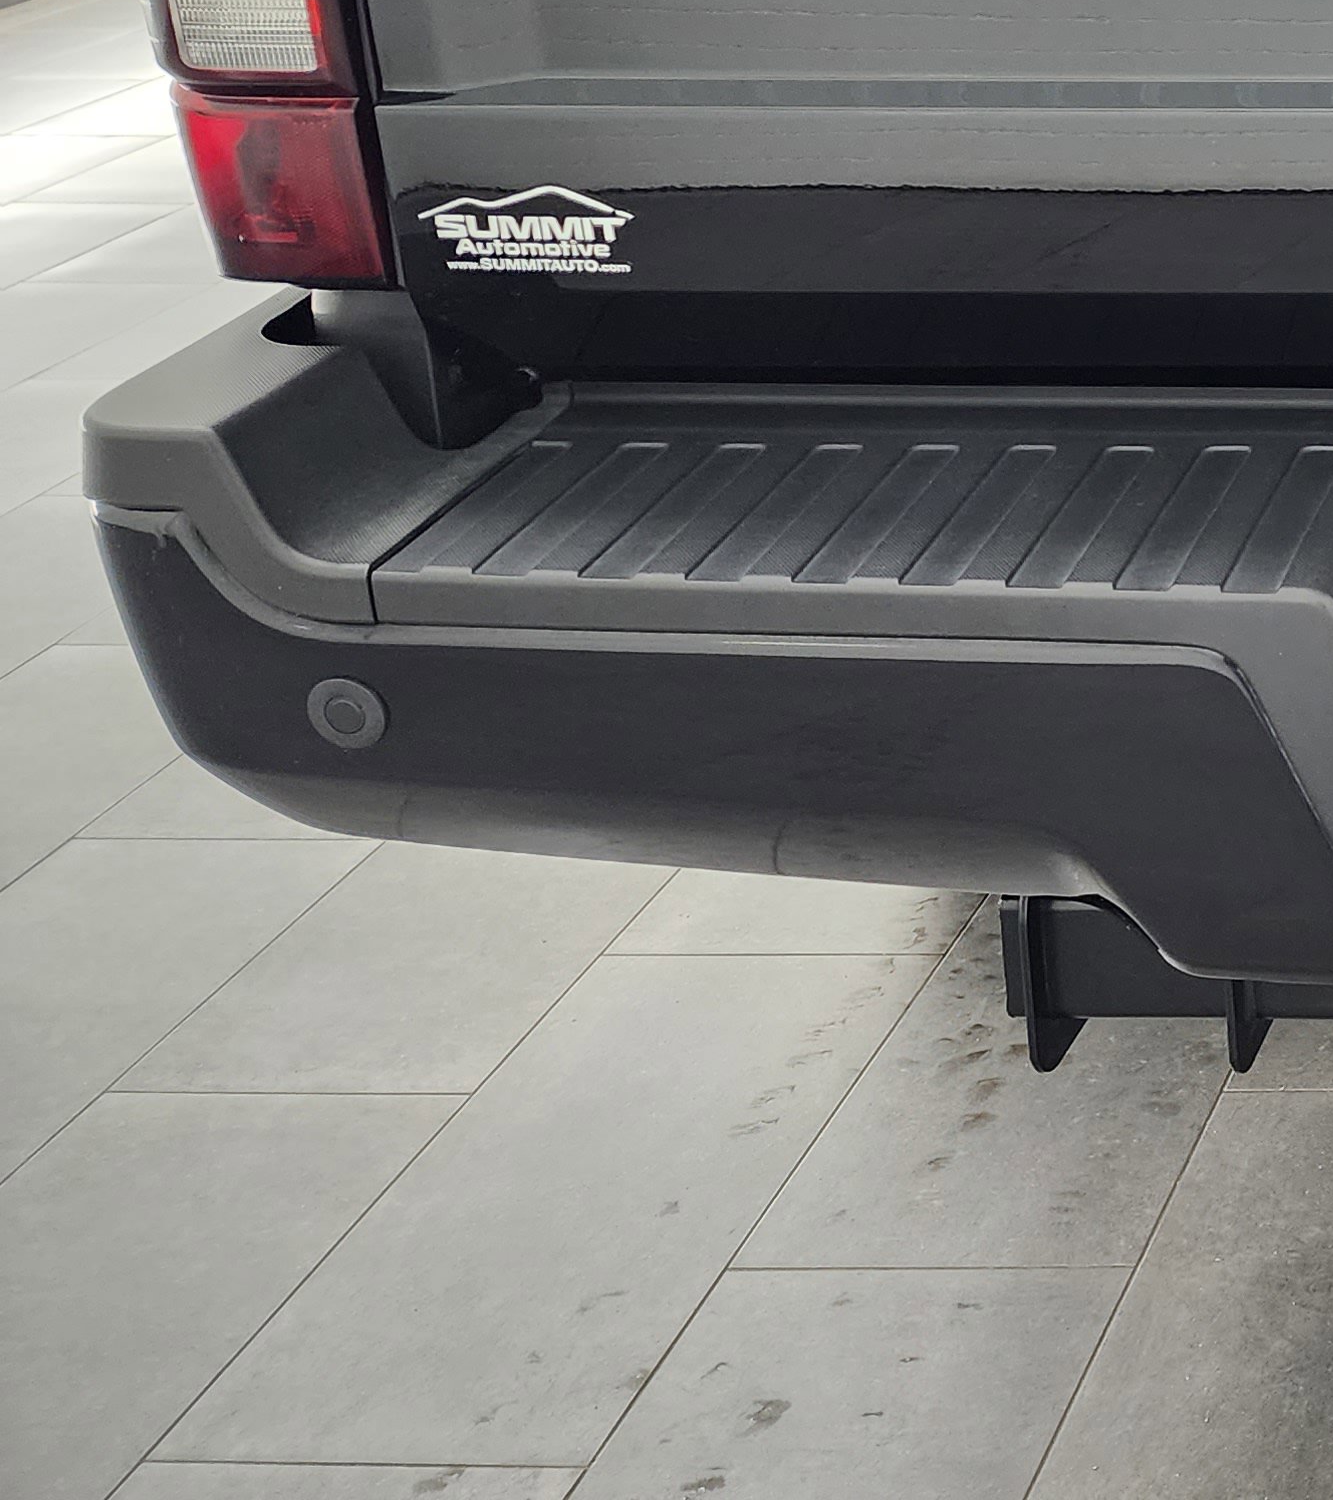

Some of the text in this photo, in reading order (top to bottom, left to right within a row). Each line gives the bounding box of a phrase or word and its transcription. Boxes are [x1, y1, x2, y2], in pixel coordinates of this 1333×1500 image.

[434, 213, 628, 242] SUMMIT
[455, 238, 612, 259] Automotive
[446, 257, 632, 274] www.SUMMITAUTO.com
